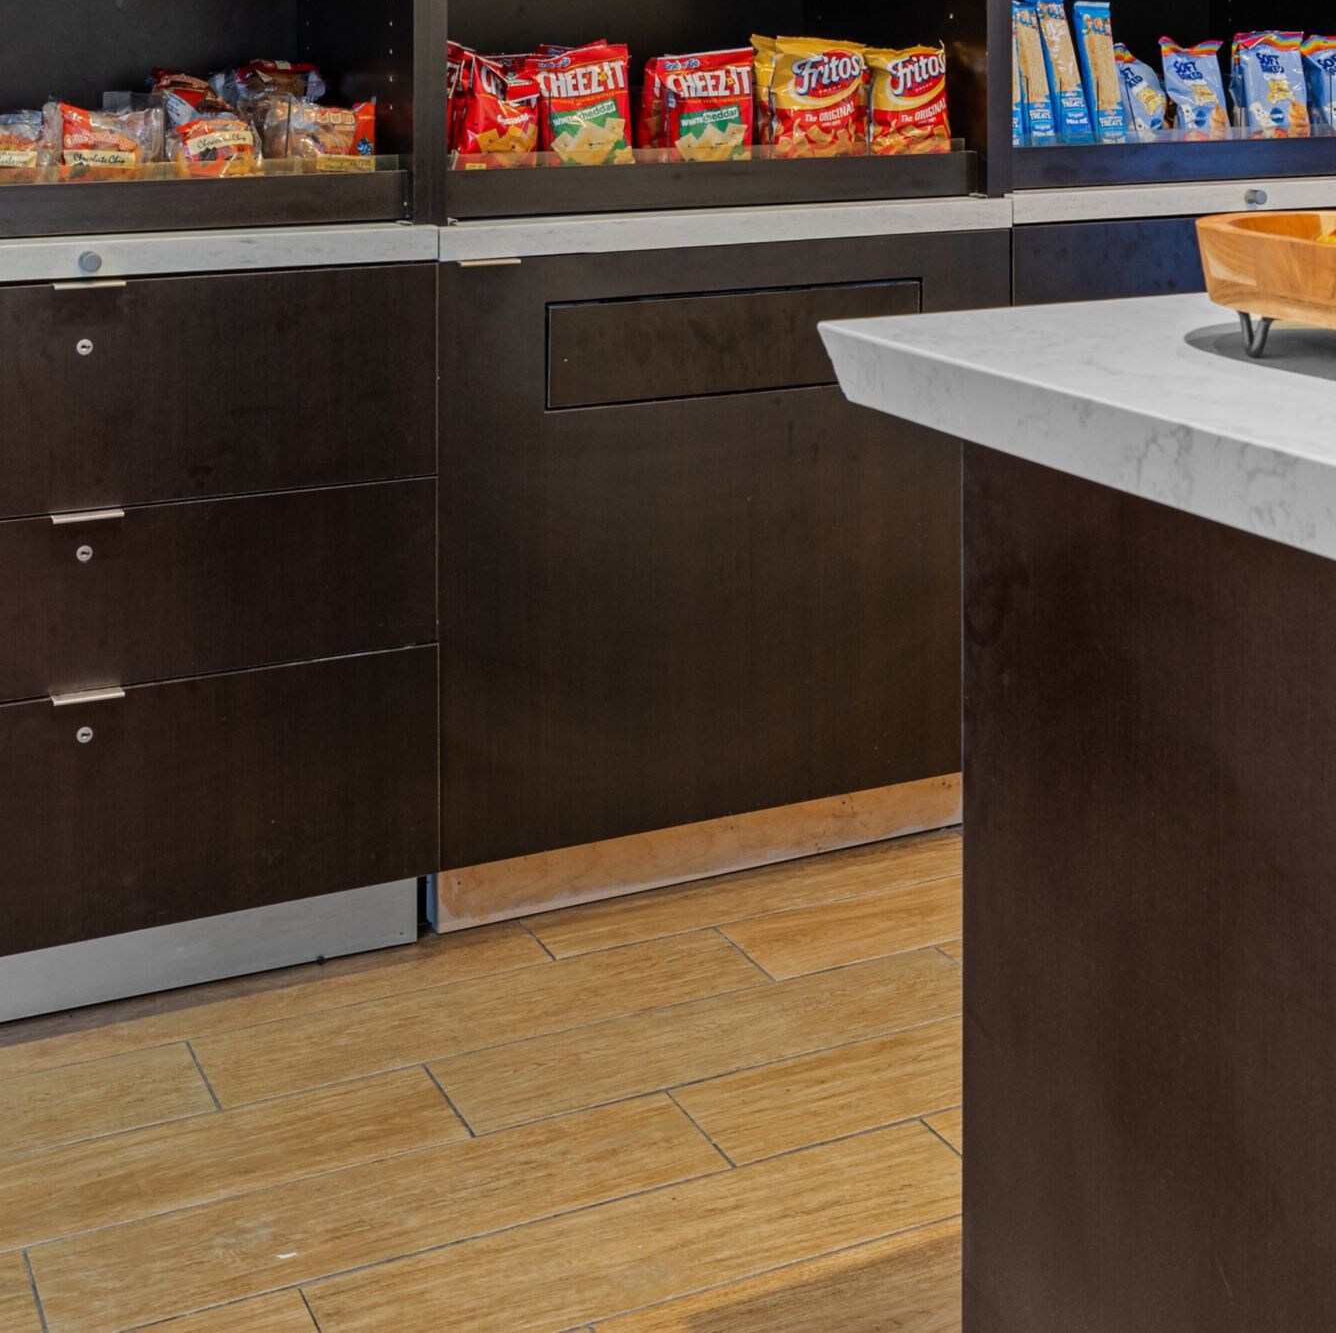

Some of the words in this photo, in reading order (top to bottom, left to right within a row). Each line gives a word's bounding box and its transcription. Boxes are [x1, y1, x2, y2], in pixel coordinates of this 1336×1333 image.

[1173, 60, 1198, 73] SOFT
[1256, 52, 1280, 66] SOFT
[792, 55, 861, 96] Fritos
[887, 55, 946, 96] Fritos
[579, 101, 616, 119] cheddar
[703, 107, 740, 123] cheddar
[805, 114, 818, 122] The
[819, 101, 854, 121] ORIGINAL
[915, 98, 947, 120] ORIGINAL
